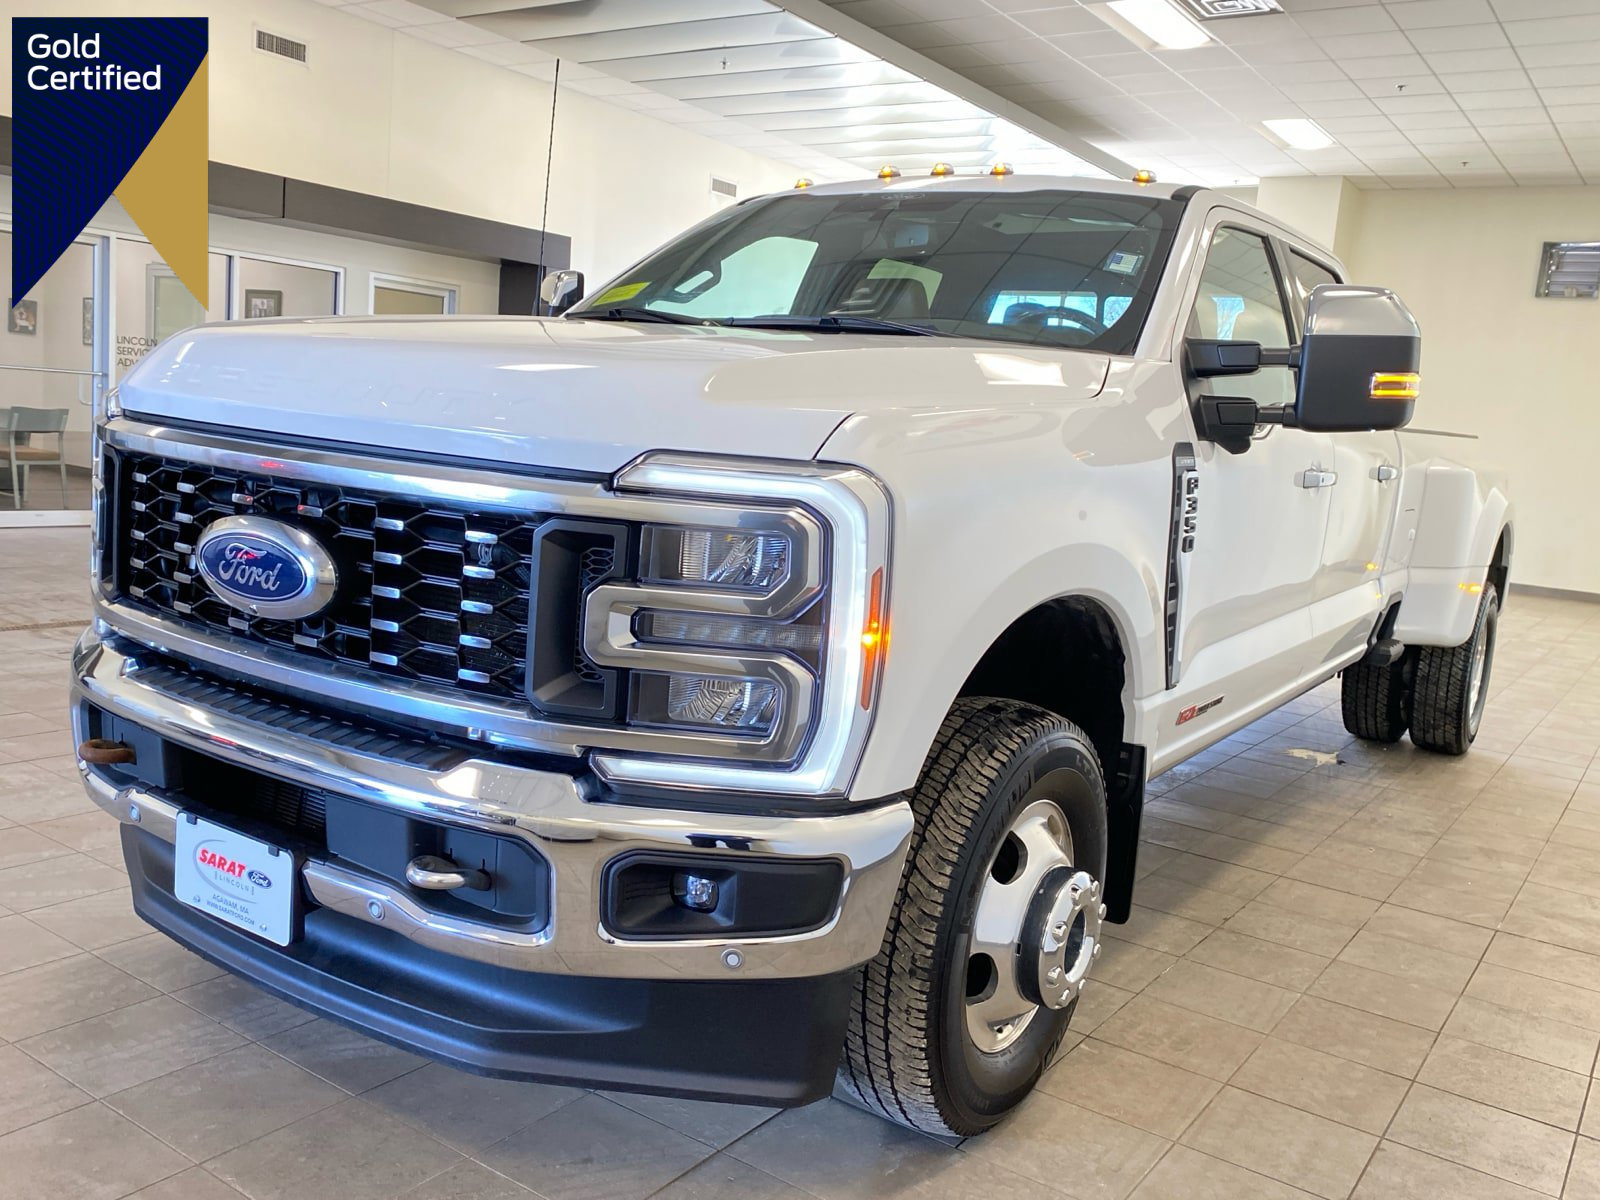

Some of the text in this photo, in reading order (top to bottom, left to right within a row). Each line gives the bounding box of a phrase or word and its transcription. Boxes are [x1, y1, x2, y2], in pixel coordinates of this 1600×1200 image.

[116, 335, 158, 347] LINCOLN
[218, 542, 283, 591] Ford
[198, 848, 247, 878] SARAT
[220, 876, 249, 891] LINCOLN
